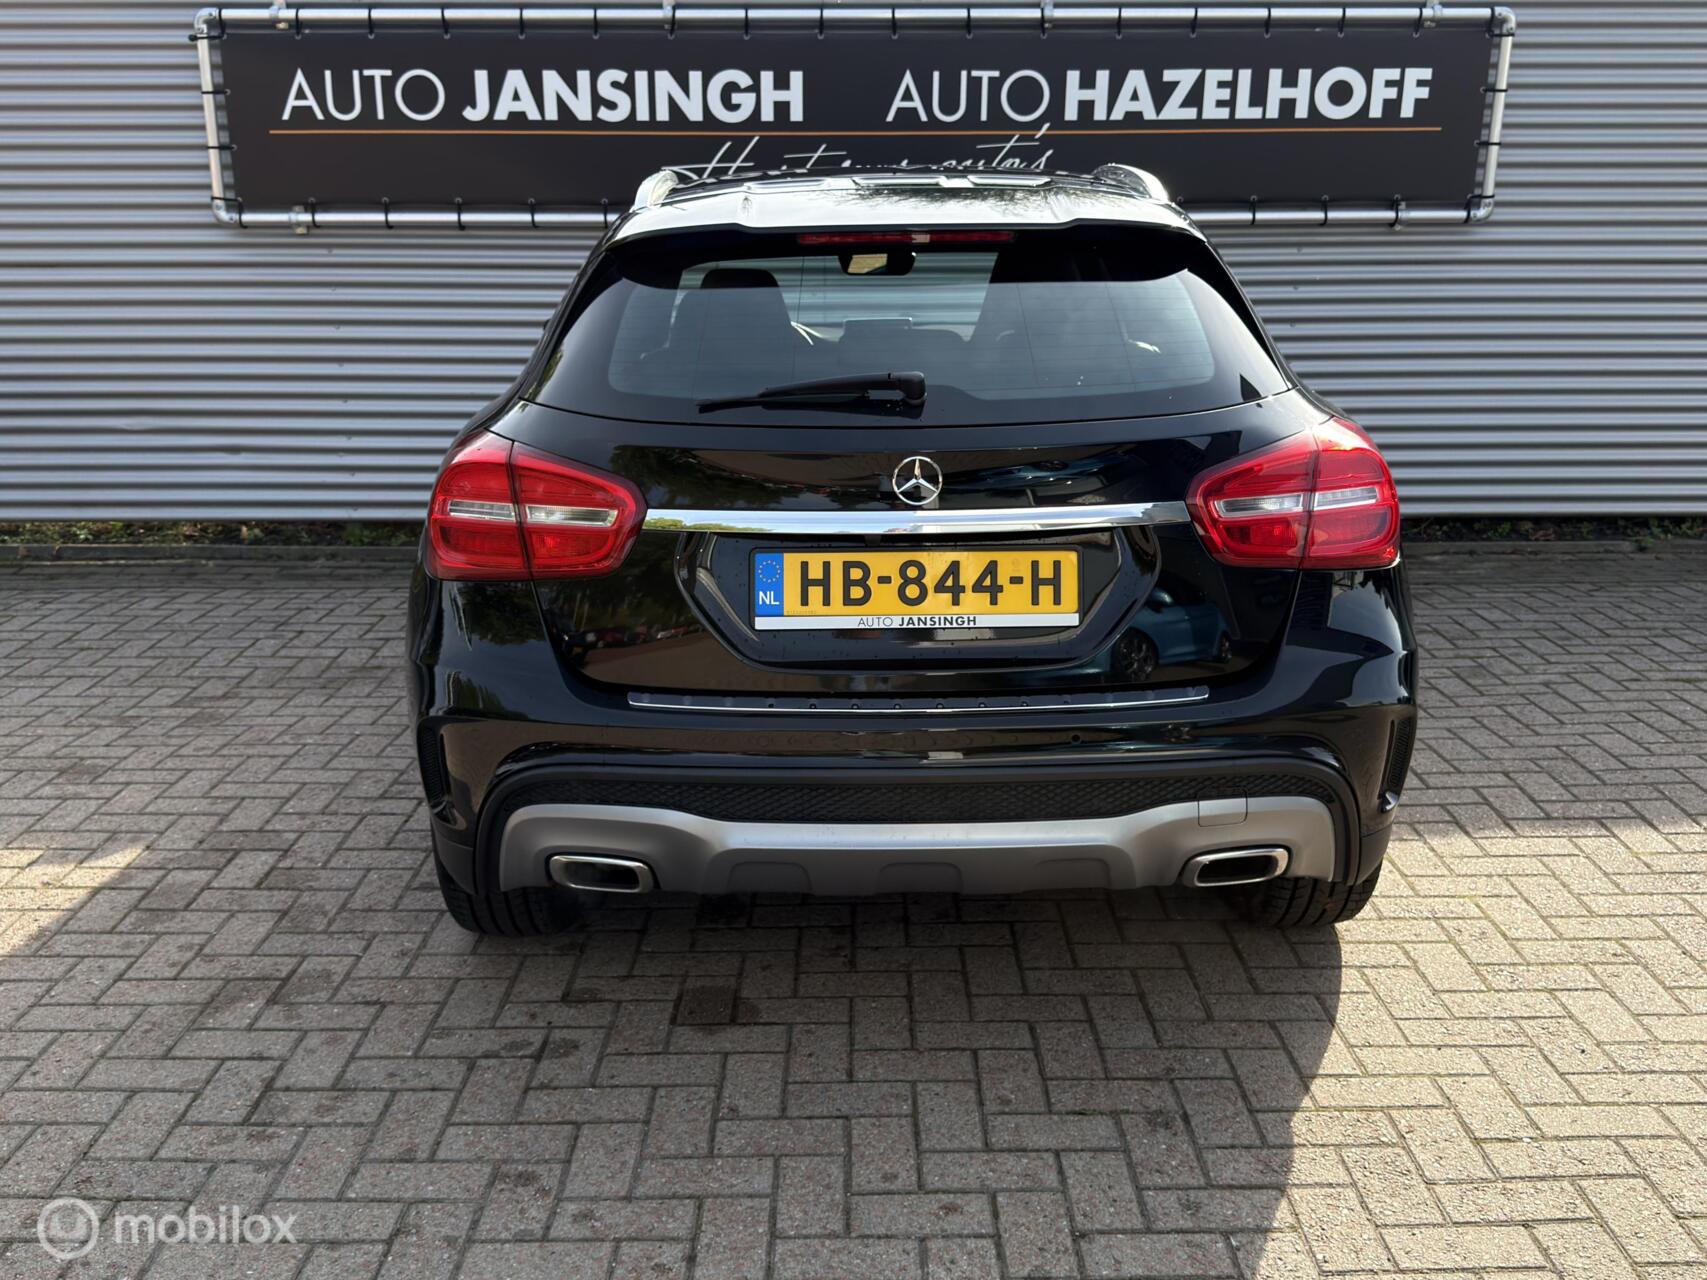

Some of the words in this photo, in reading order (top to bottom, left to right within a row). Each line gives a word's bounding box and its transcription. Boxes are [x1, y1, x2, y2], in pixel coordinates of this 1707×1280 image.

[281, 68, 446, 121] AUTO
[462, 69, 804, 122] JANSINGH
[885, 69, 1050, 122] AUTO
[1064, 67, 1433, 120] HAZELHOFF
[758, 590, 780, 605] NL
[800, 560, 1062, 607] HB-844-H
[857, 616, 894, 628] AUTO
[898, 616, 977, 628] JANSINGH
